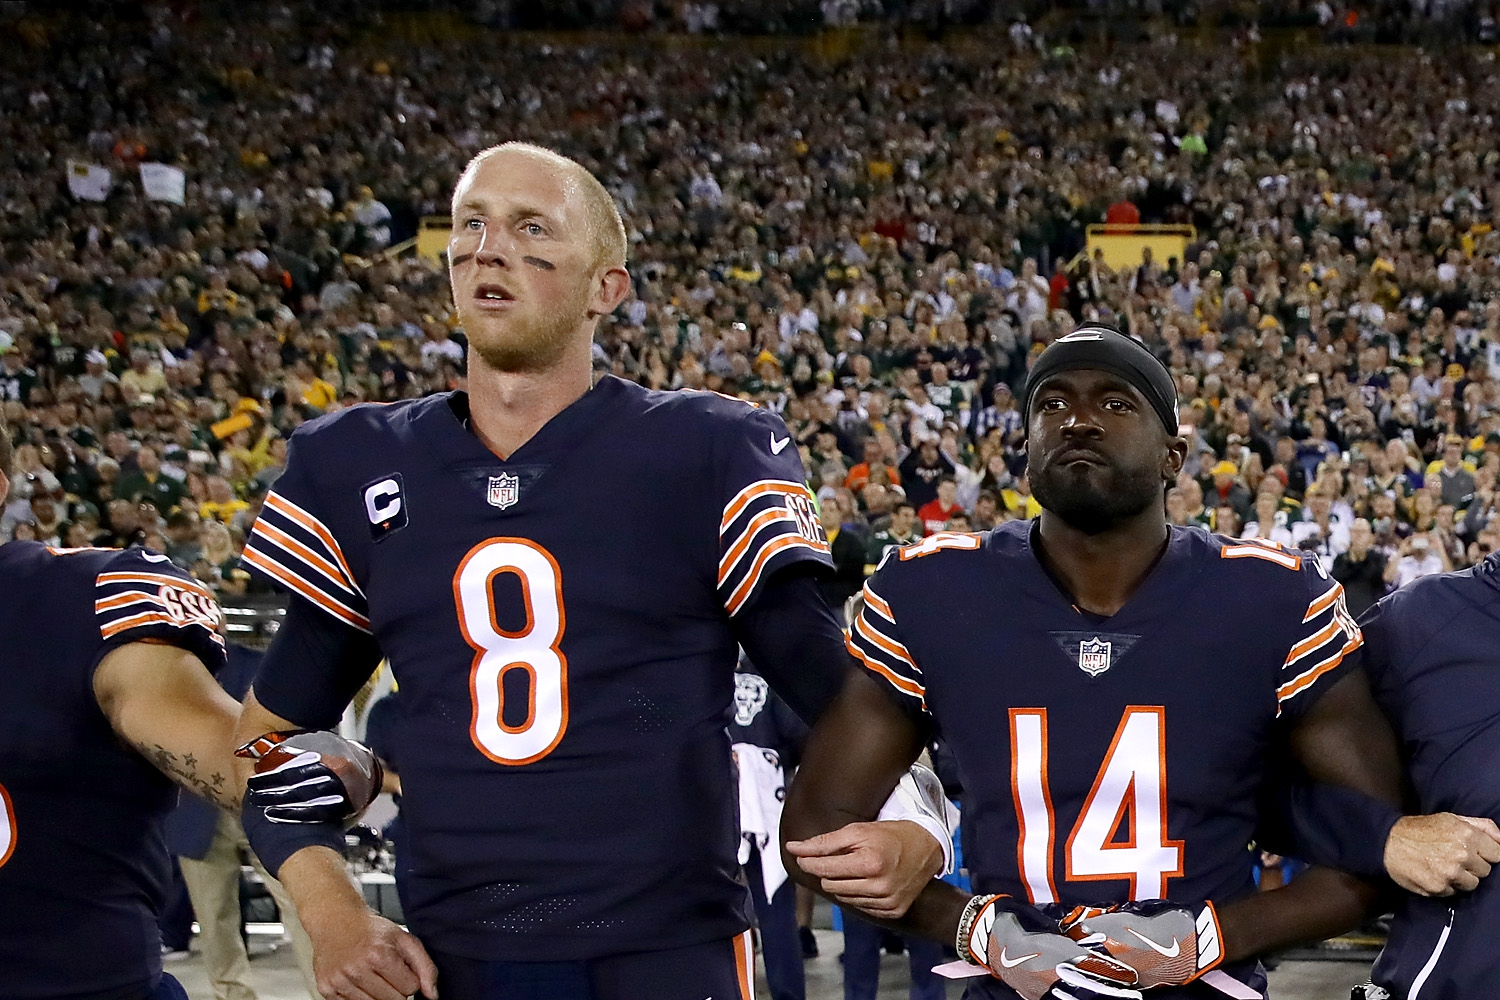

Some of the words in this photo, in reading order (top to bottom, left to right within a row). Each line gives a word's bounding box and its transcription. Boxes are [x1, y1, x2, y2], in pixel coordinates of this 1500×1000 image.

[365, 479, 401, 525] C
[452, 536, 570, 767] 8
[1008, 705, 1186, 905] 14
